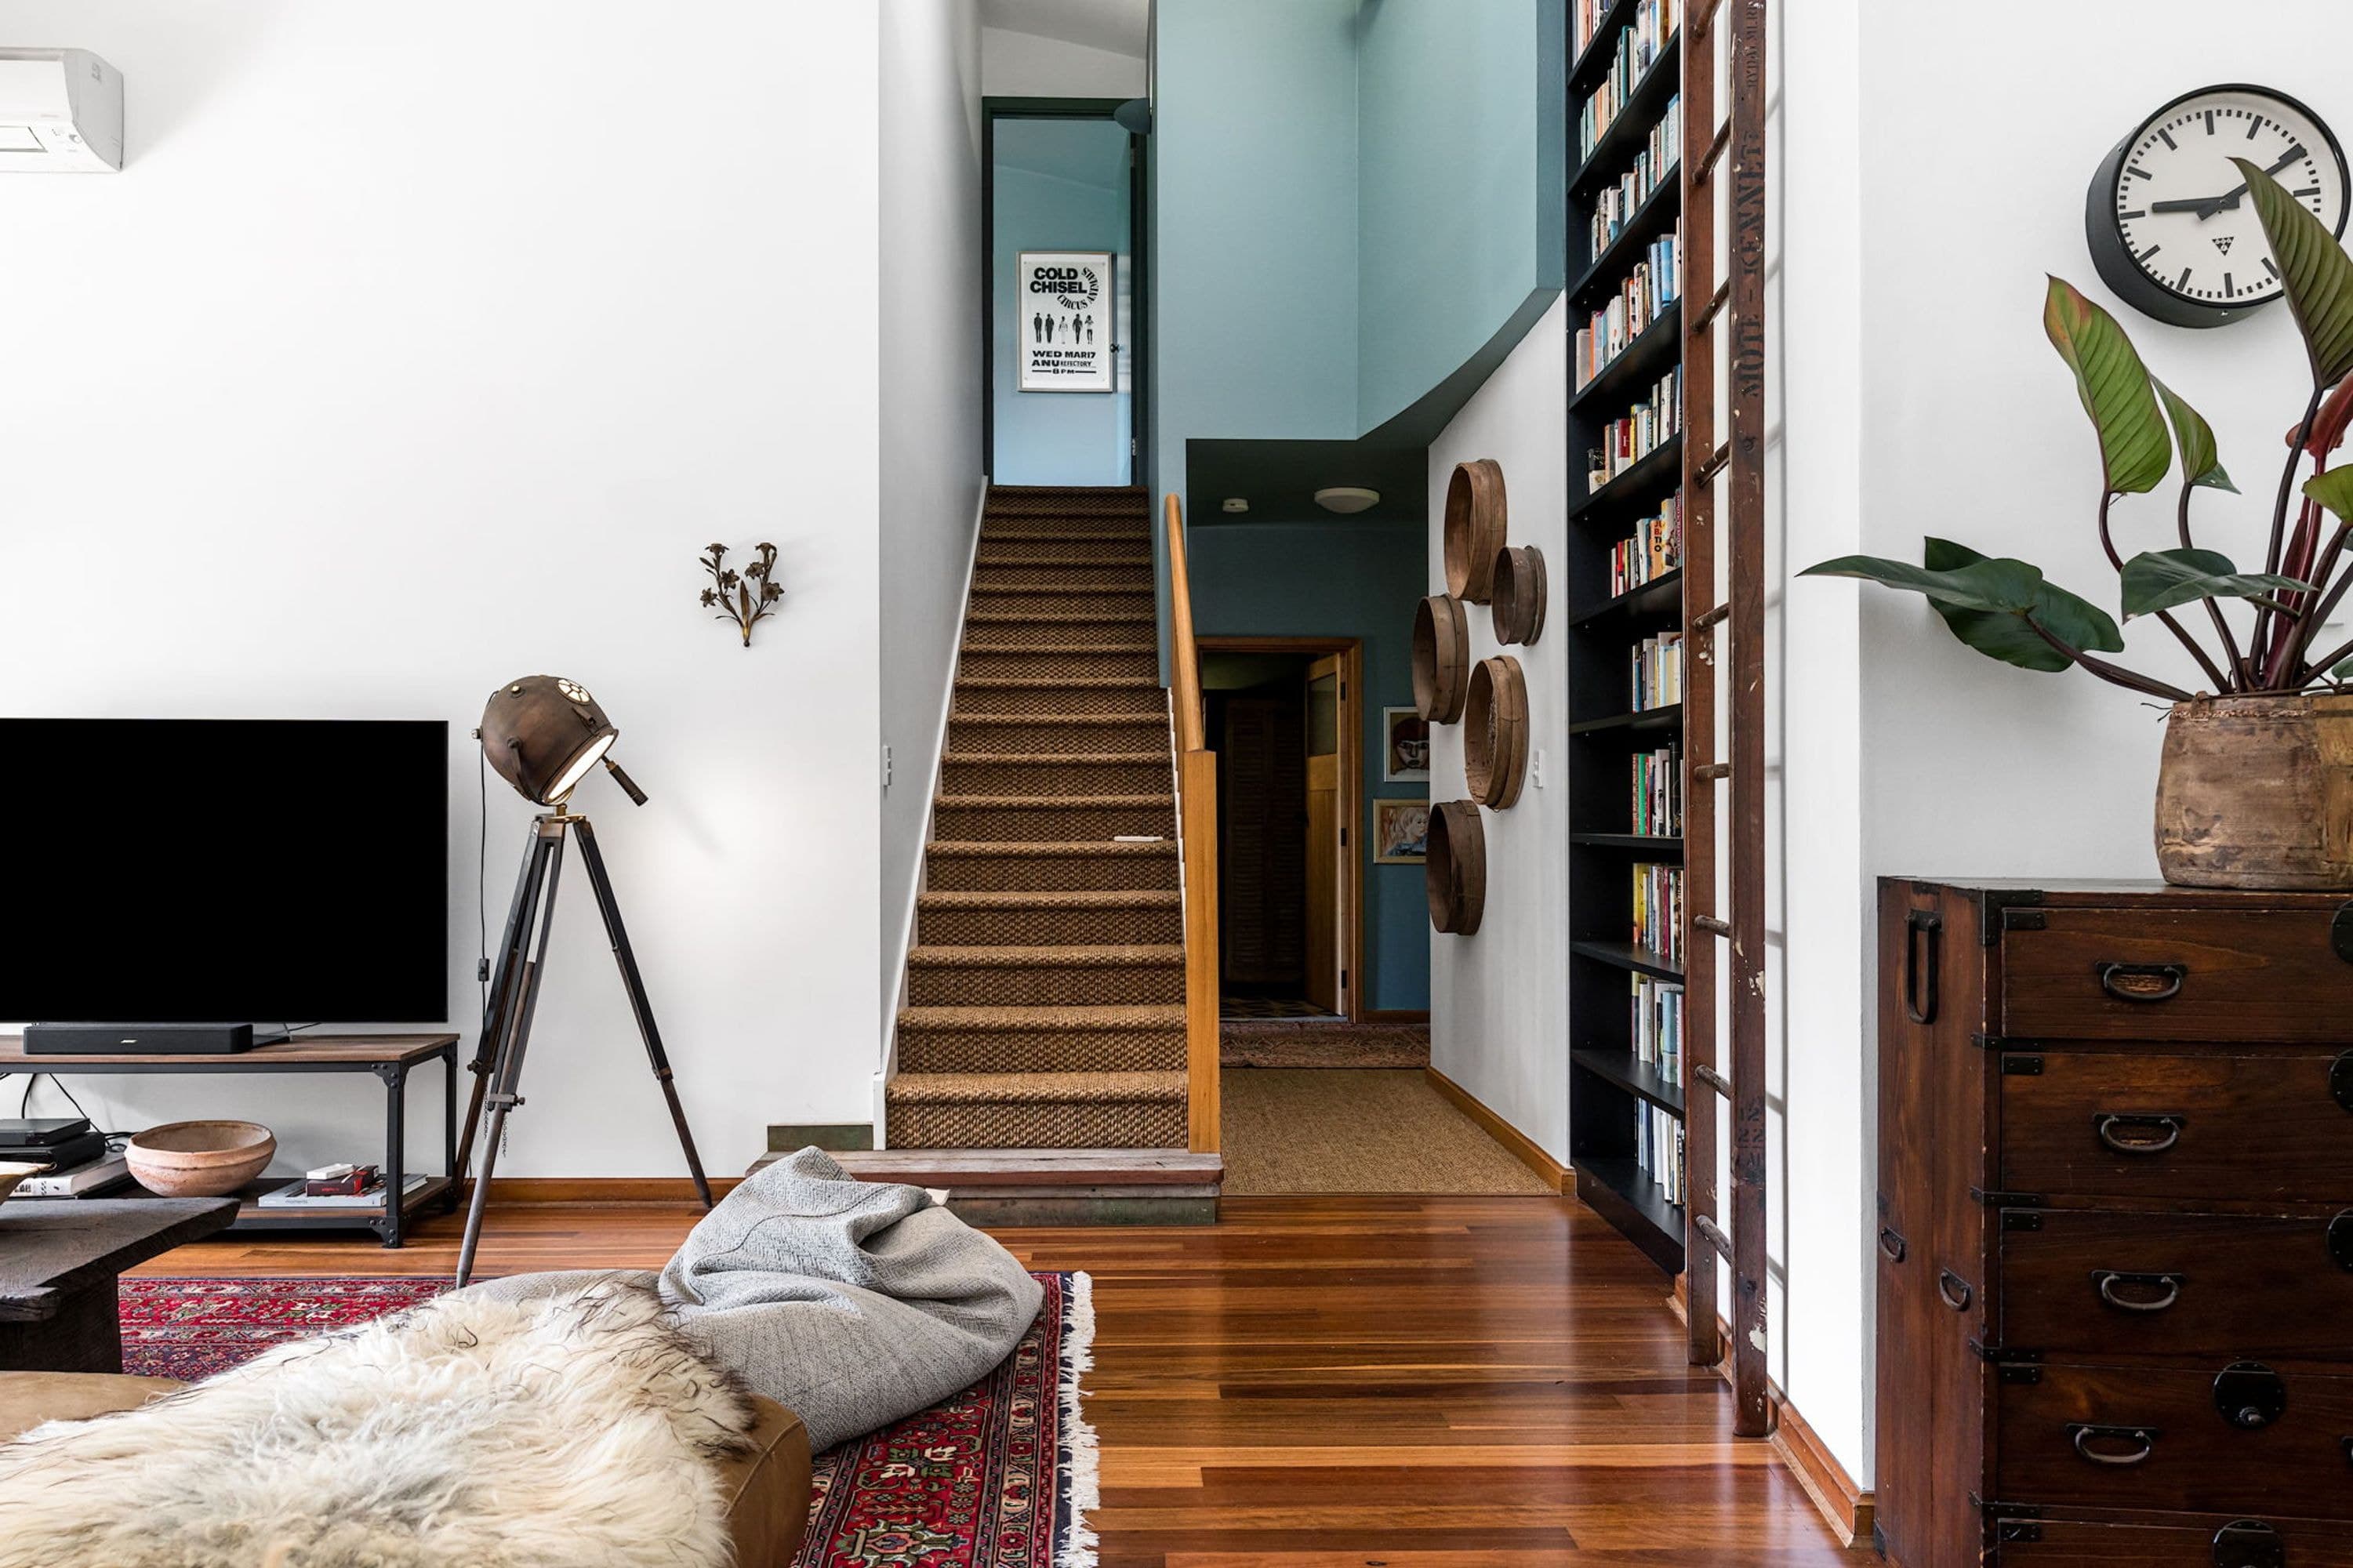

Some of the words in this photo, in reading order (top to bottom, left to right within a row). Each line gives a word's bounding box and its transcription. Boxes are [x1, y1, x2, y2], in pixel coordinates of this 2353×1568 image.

[1033, 267, 1078, 280] COLD
[1029, 281, 1088, 293] CHISEL
[1057, 294, 1088, 310] CIRCUS
